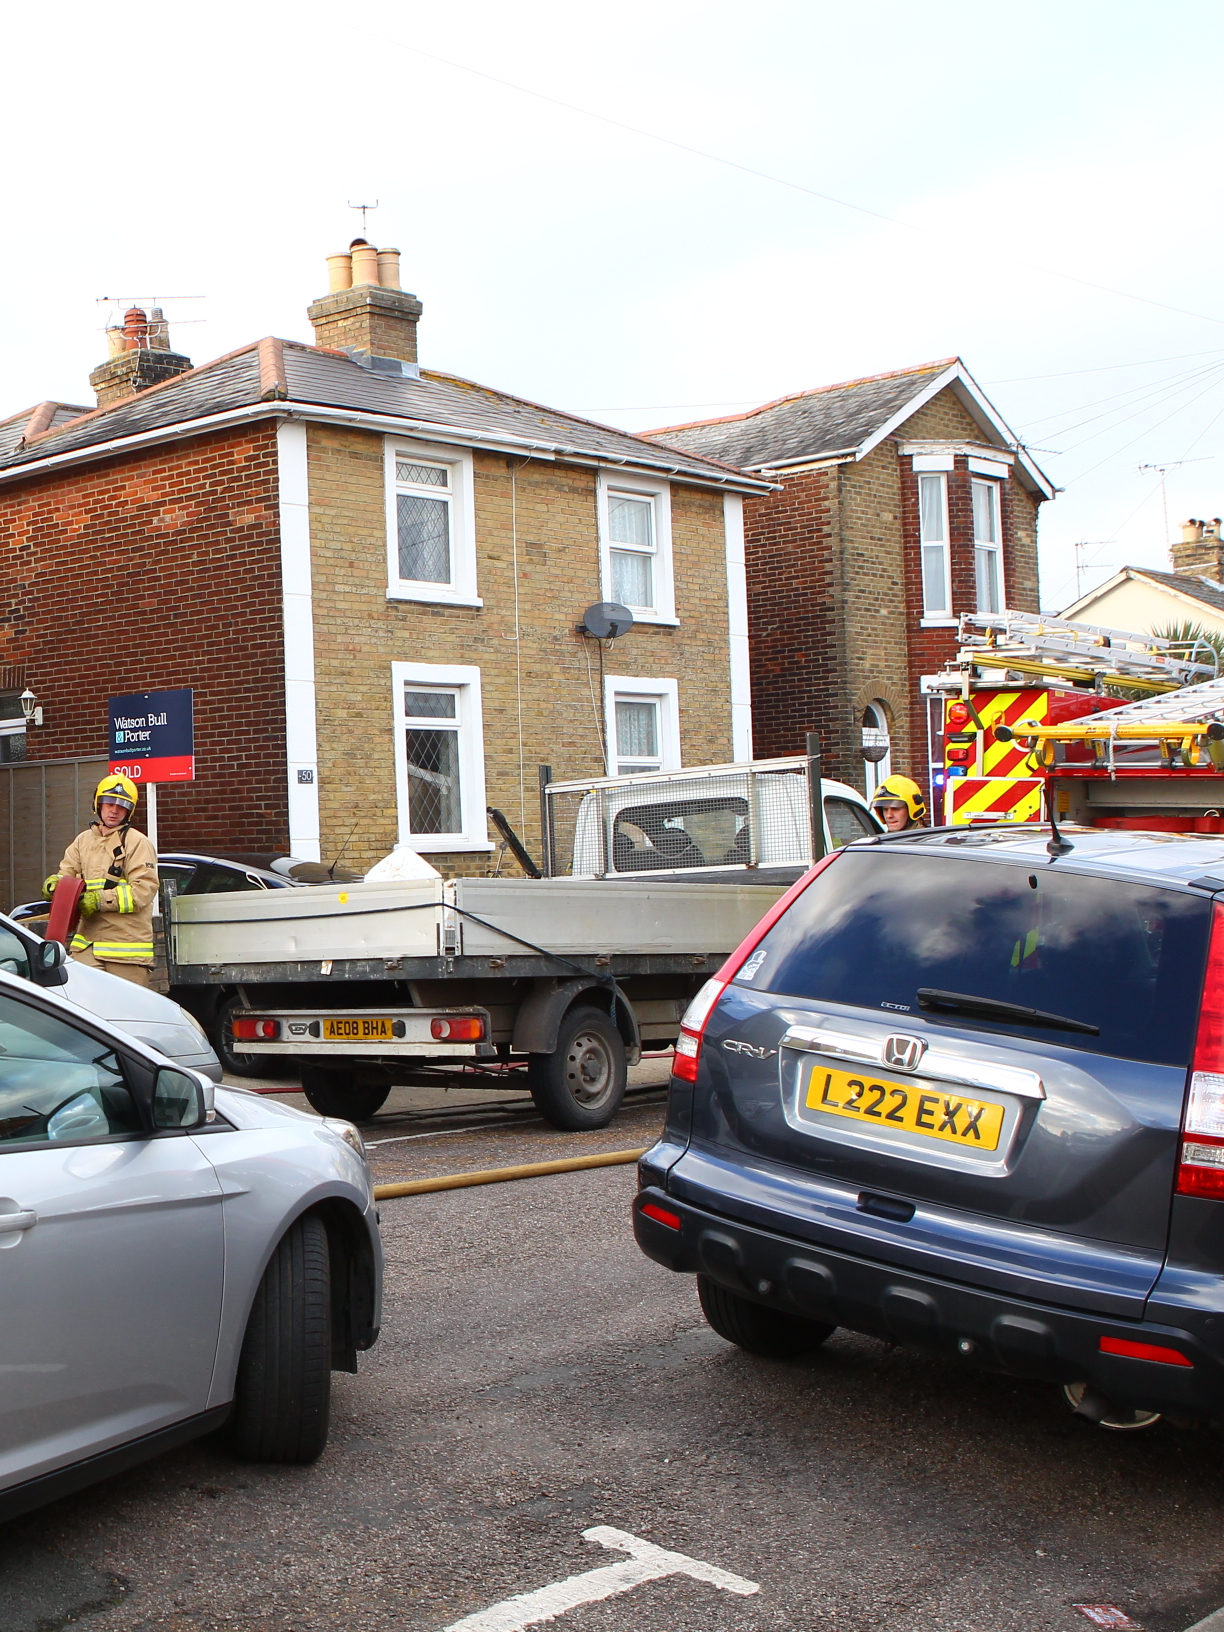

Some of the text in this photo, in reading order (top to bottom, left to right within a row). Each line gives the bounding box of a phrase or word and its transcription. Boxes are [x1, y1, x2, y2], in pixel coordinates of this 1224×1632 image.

[114, 712, 167, 730] Watson Bull
[125, 730, 152, 743] Porter
[114, 765, 142, 778] SOLD
[301, 770, 312, 781] 50
[329, 1020, 388, 1036] AE08 BHA
[721, 1039, 778, 1060] CR-V
[821, 1074, 986, 1141] L222 EXX
